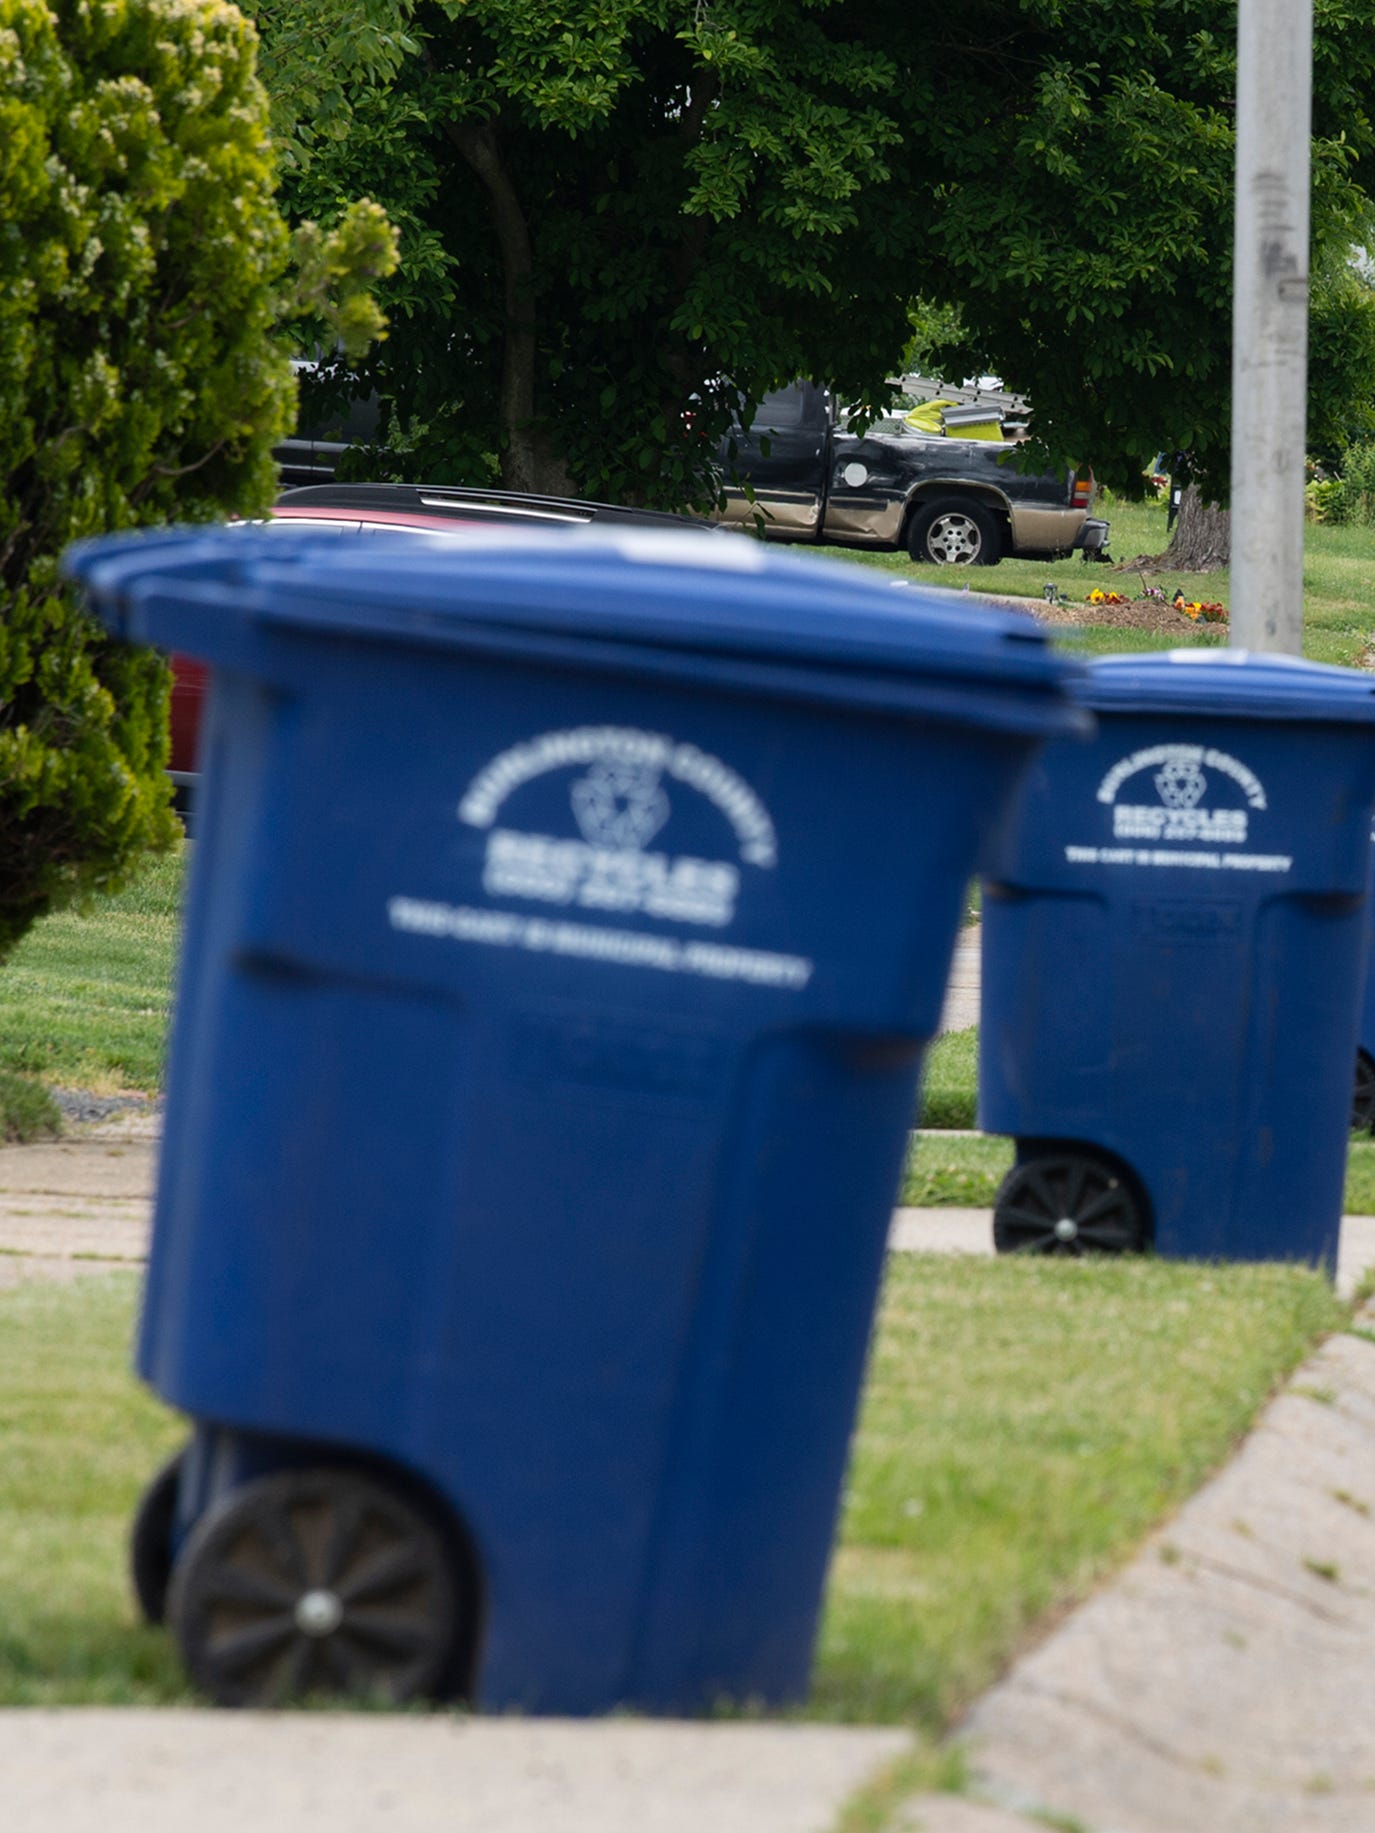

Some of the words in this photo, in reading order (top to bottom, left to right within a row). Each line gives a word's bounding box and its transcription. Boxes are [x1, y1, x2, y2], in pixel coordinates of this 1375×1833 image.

[1204, 748, 1268, 810] COUNTY
[1114, 804, 1249, 827] RECYCLES
[1221, 852, 1294, 872] PROPERTY
